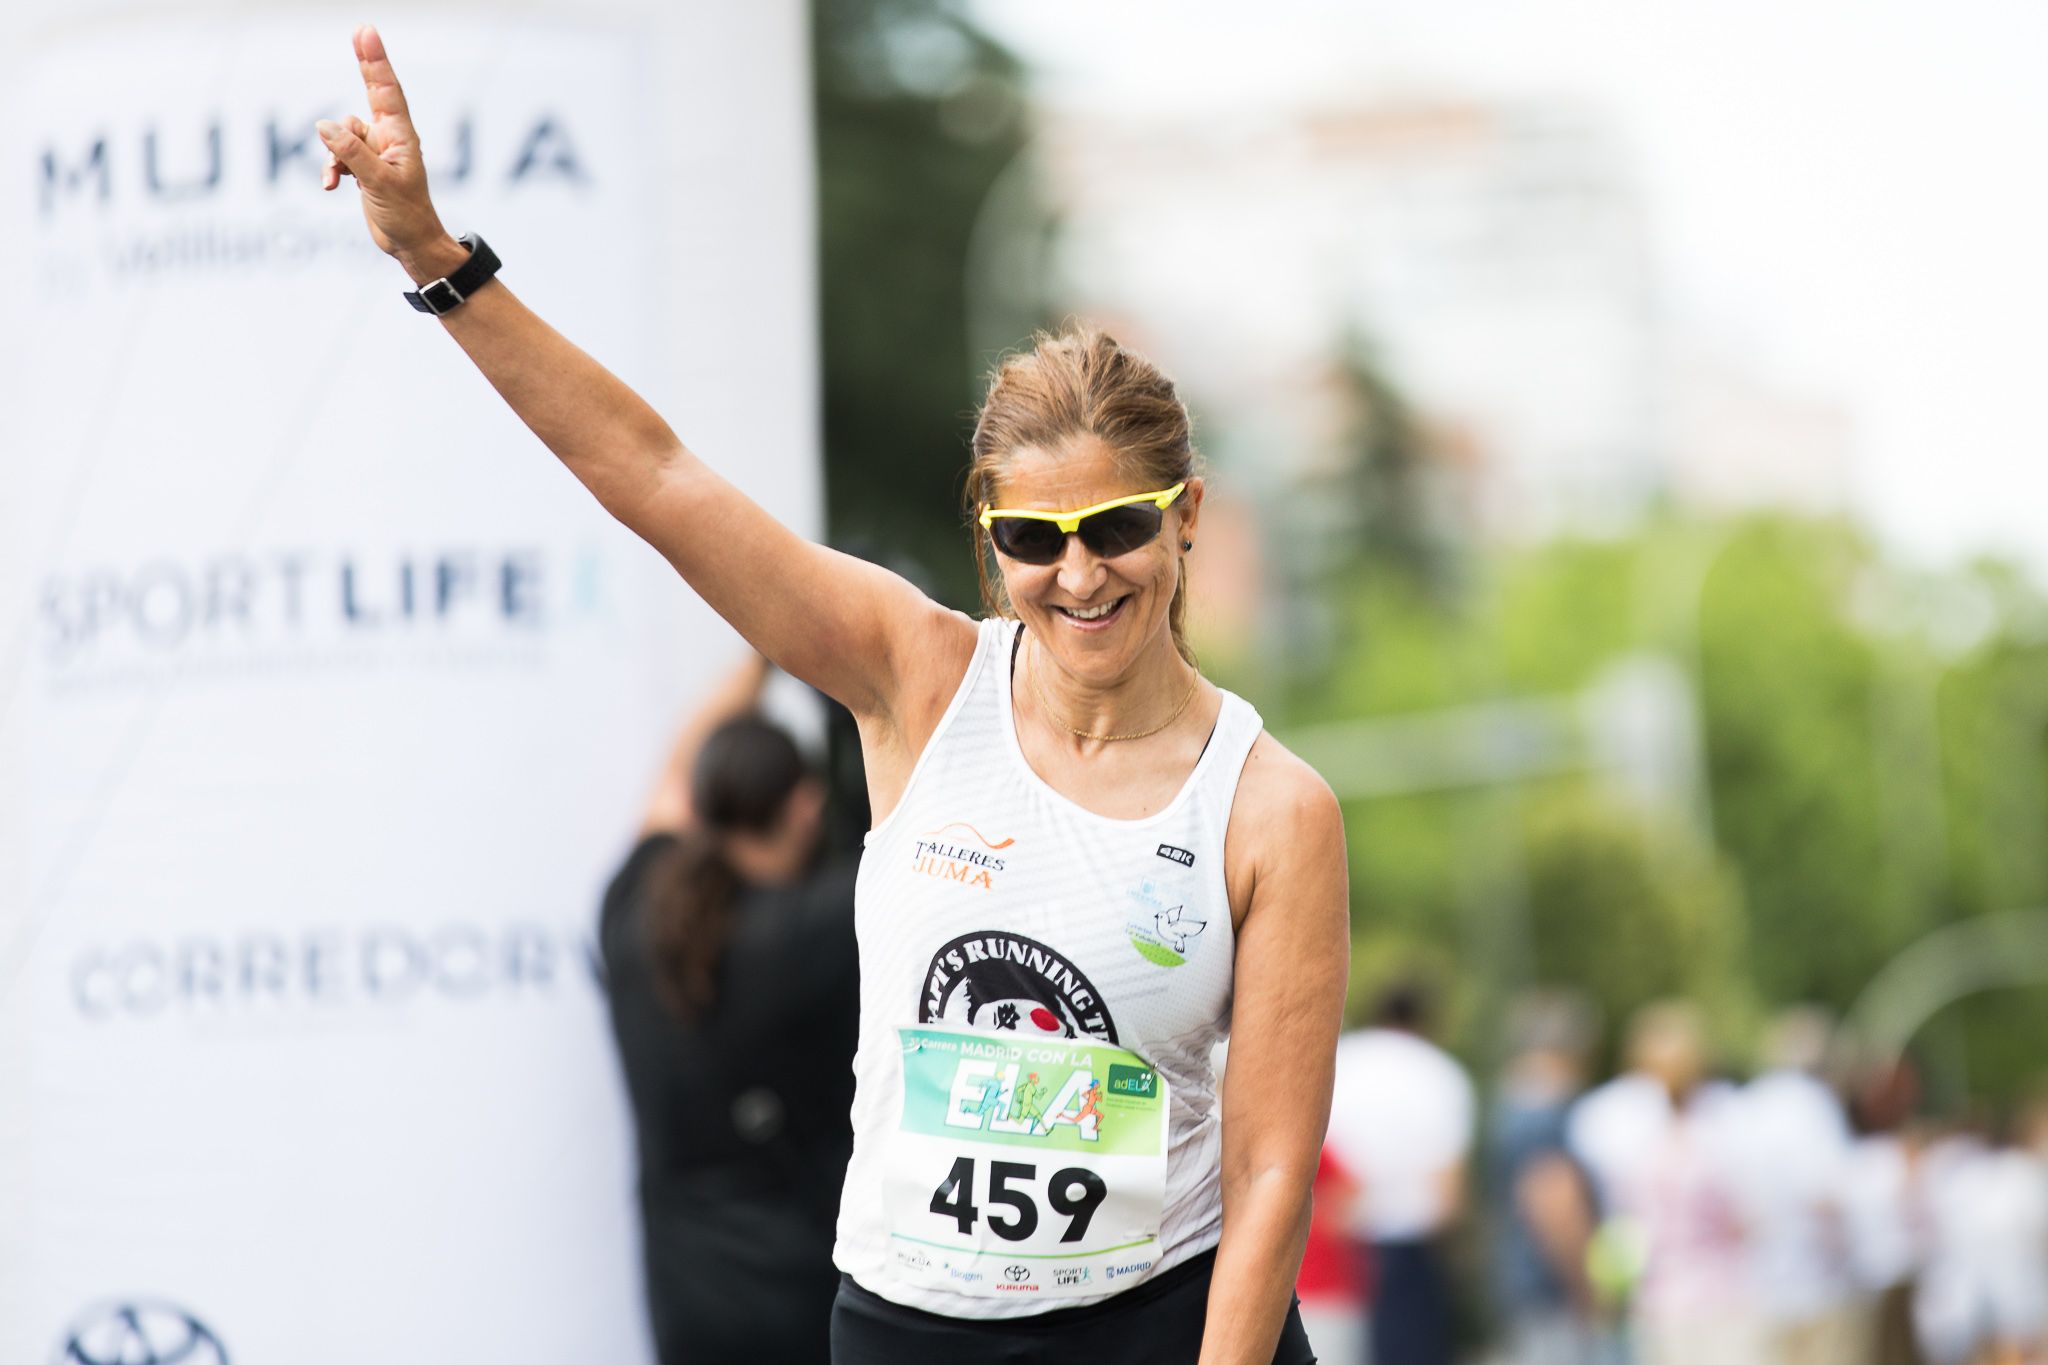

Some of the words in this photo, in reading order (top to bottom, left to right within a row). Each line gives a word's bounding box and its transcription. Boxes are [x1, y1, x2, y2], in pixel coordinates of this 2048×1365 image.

[338, 542, 548, 630] LIFE
[912, 856, 992, 889] JUMA
[915, 841, 1005, 872] TALLERES
[963, 938, 1094, 1012] RUNNING
[960, 1041, 1023, 1061] MADRID
[1027, 1048, 1067, 1066] CON
[1070, 1053, 1093, 1068] LA
[944, 1058, 1099, 1142] ELA
[929, 1156, 1108, 1244] 459
[1057, 1276, 1080, 1286] LIFE
[1116, 1261, 1152, 1276] MADRID
